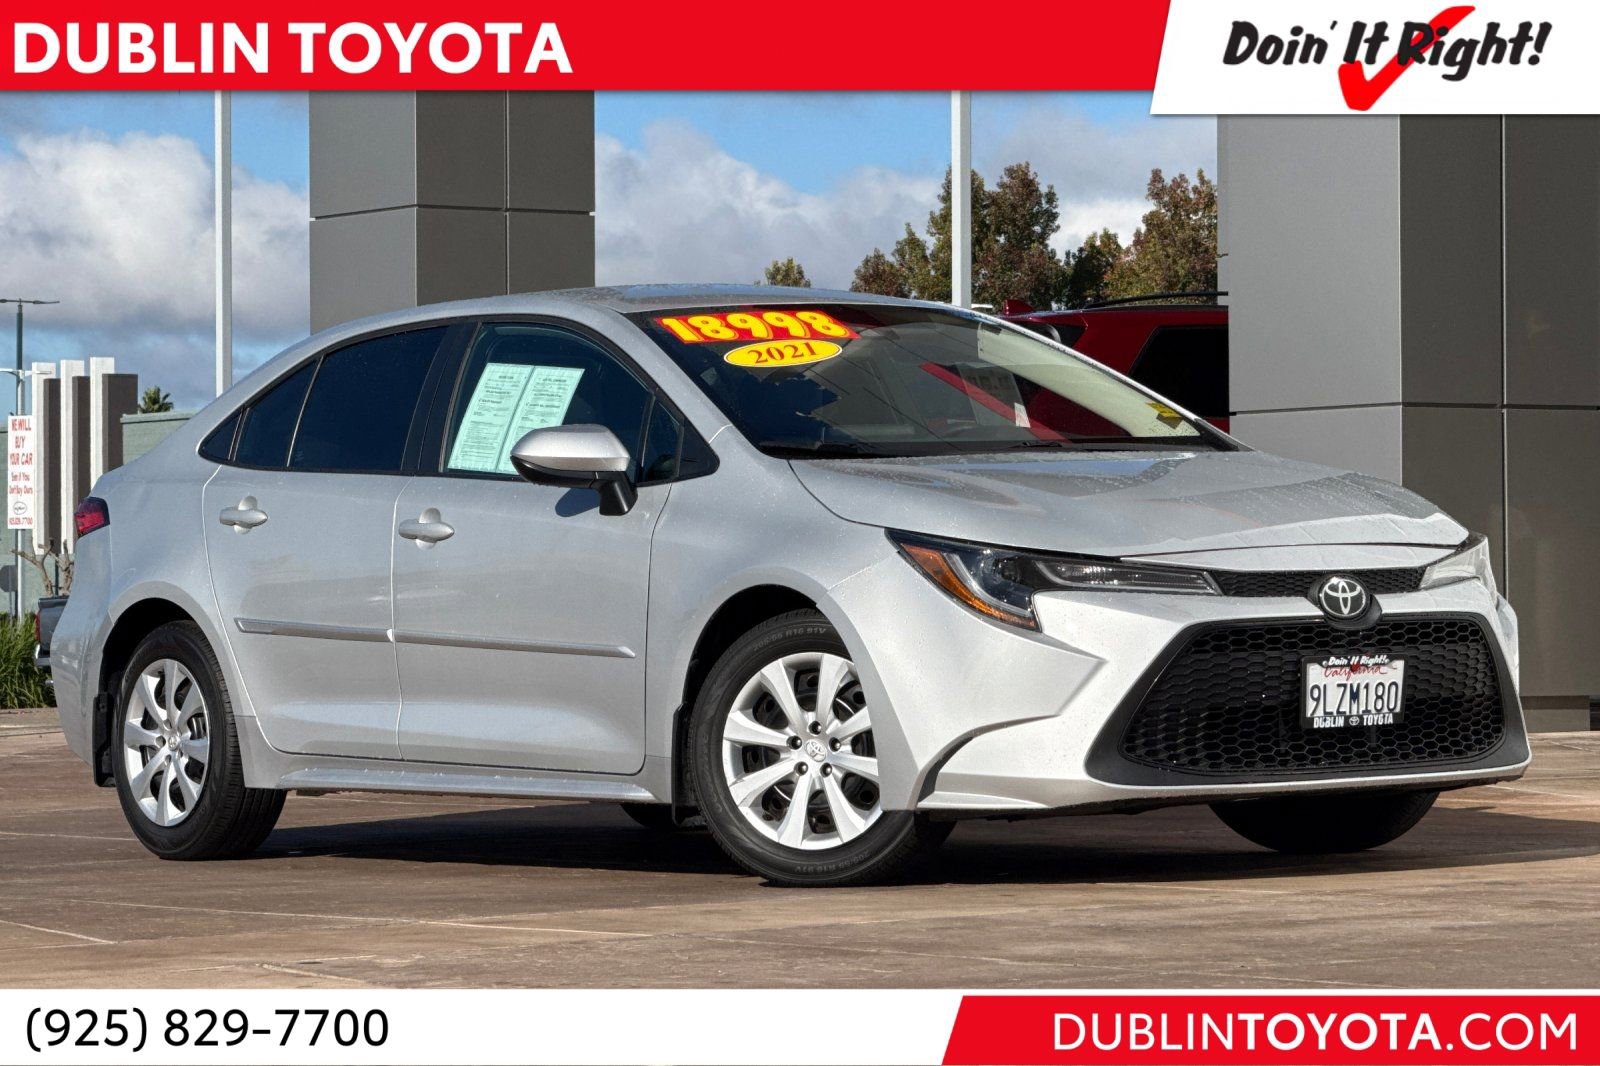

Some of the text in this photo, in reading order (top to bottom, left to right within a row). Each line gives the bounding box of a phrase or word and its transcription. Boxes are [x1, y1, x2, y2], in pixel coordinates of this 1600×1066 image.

[661, 311, 851, 342] 18998
[747, 342, 818, 364] 2021
[21, 452, 33, 465] CAR
[1309, 681, 1400, 716] 9LZM180
[1313, 713, 1394, 728] DUBLIN TOYOTA
